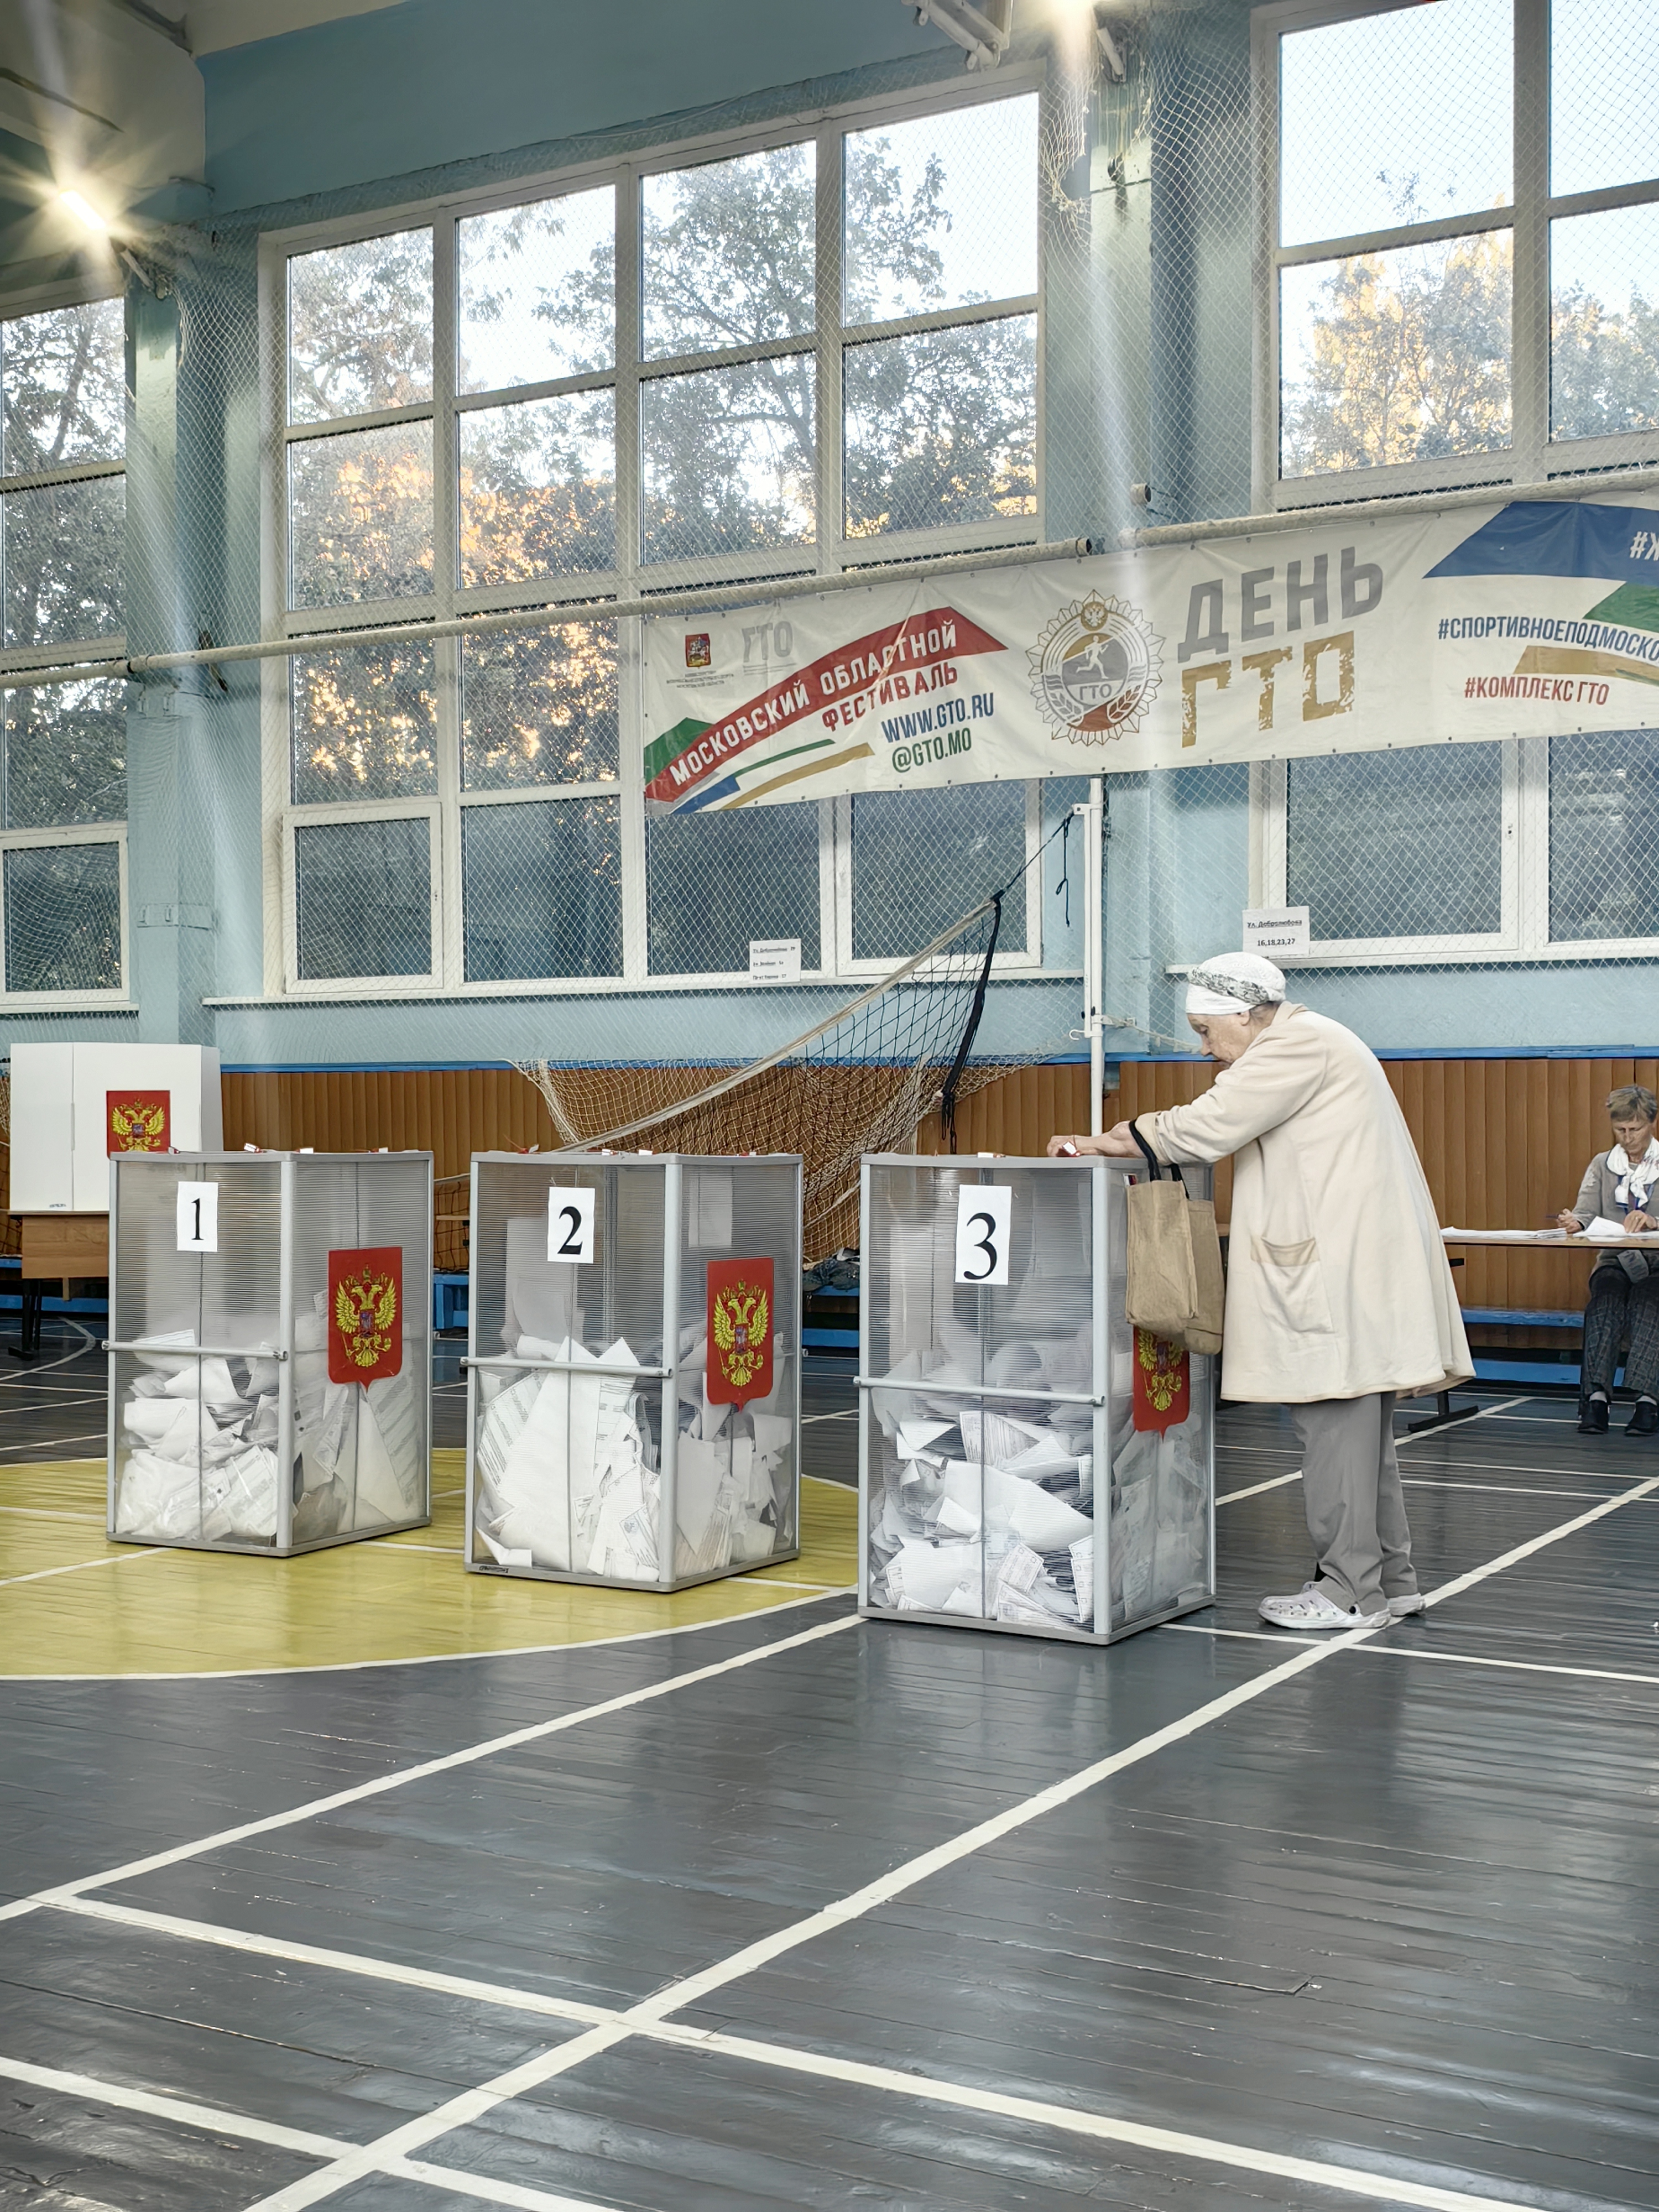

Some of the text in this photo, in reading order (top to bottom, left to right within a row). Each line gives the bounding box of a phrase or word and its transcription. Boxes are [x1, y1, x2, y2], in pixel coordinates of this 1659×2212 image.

[1178, 546, 1383, 663] ДЕНЬ
[742, 621, 793, 663] ГТО
[669, 619, 957, 786] МОСКОВСКИЙ ОБЛАСТНОЙ
[822, 662, 957, 732] ФЕСТИВАЛЬ
[1079, 684, 1112, 700] ГТО
[1182, 631, 1354, 748] ГТО
[1464, 676, 1610, 705] #КОМПЛЕКС ГТО
[881, 692, 994, 743] WWW.GTO.RU
[892, 728, 972, 773] @GTO.MO
[191, 1198, 204, 1240] 1
[557, 1206, 583, 1255] 2
[964, 1212, 997, 1280] 3
